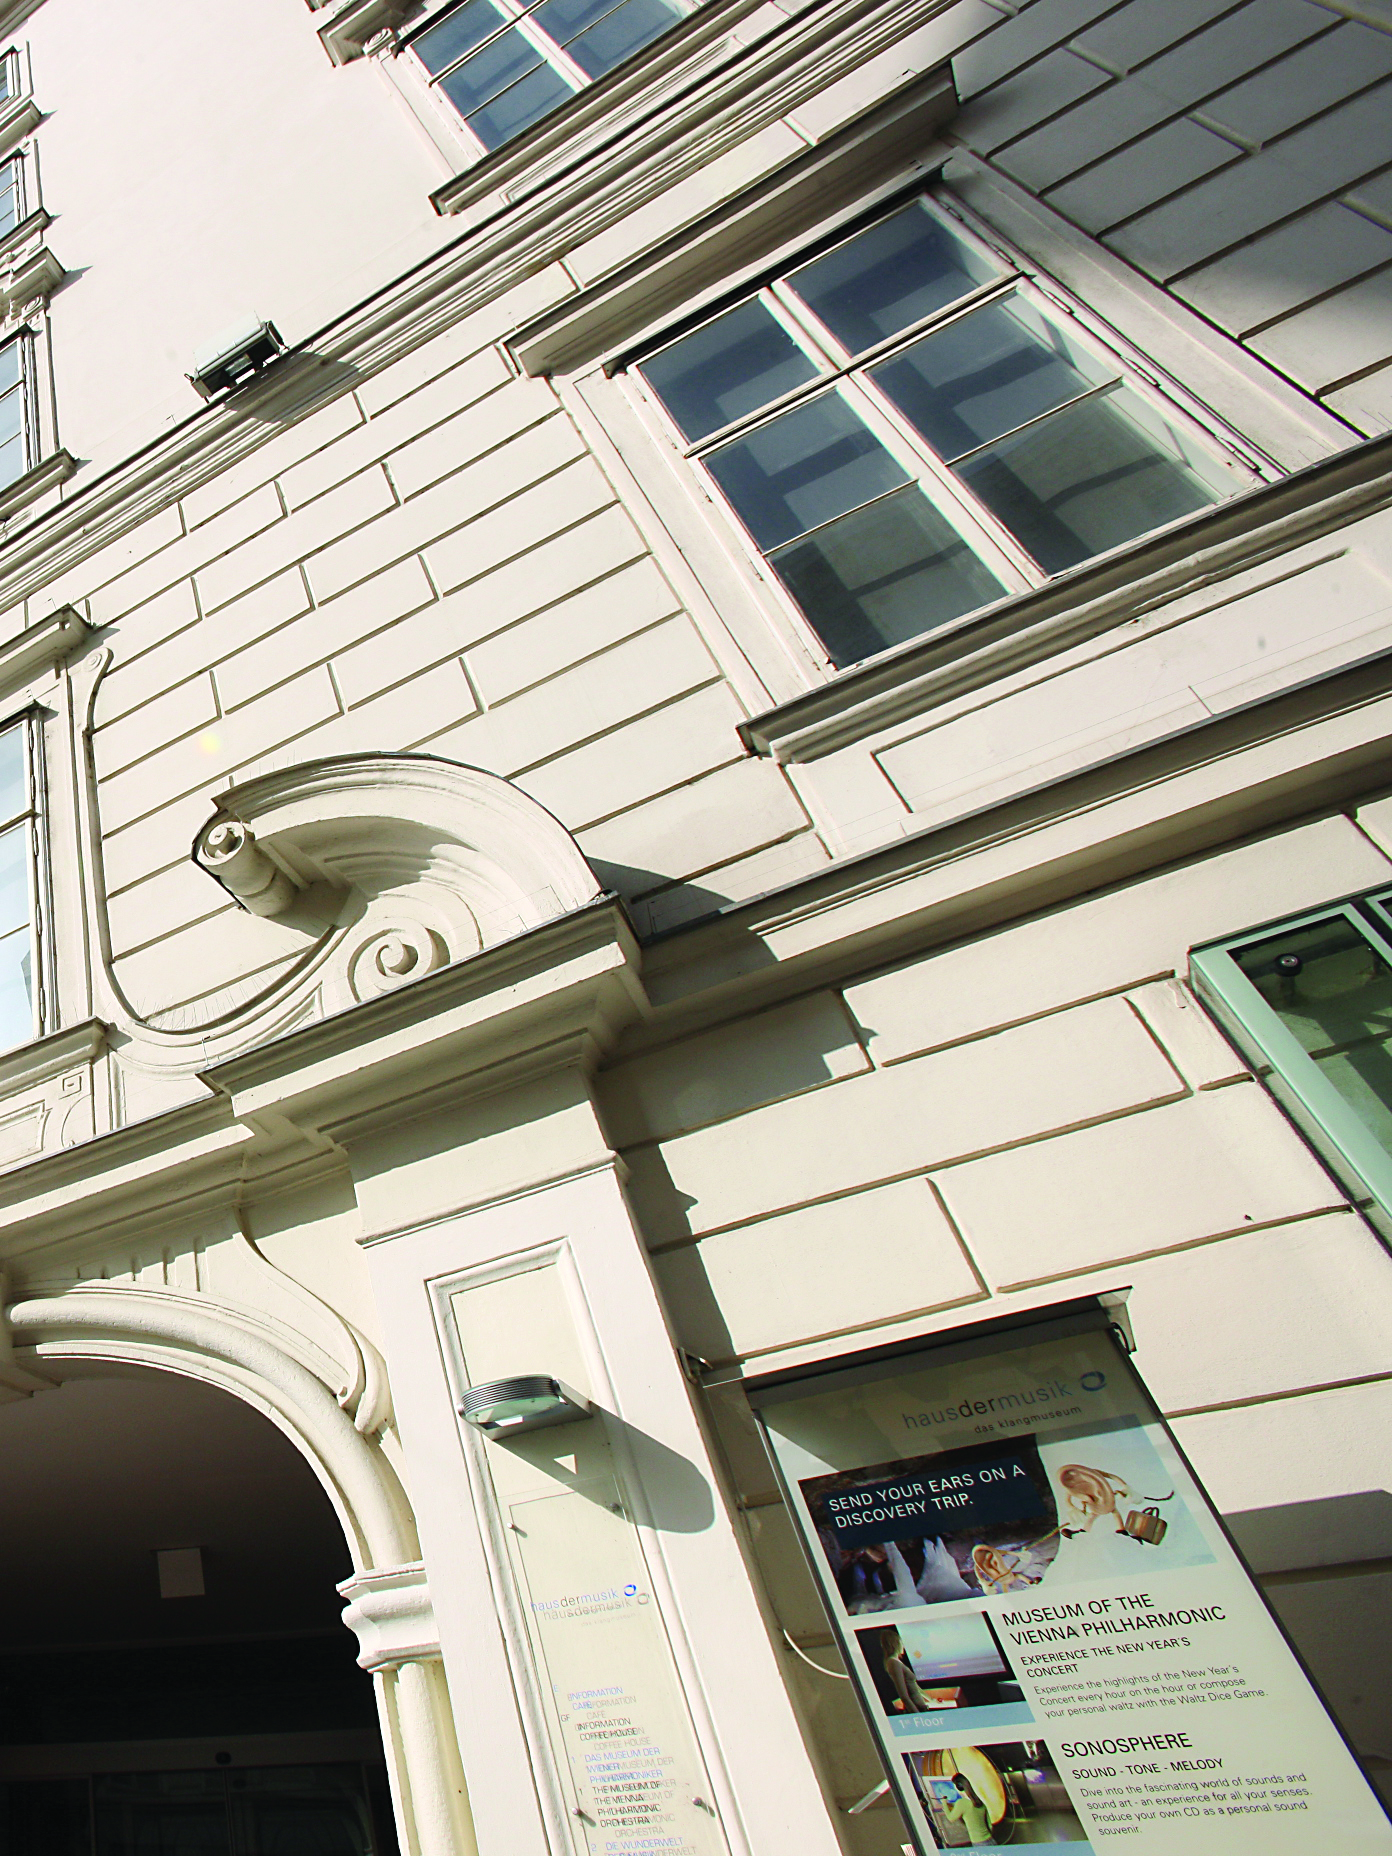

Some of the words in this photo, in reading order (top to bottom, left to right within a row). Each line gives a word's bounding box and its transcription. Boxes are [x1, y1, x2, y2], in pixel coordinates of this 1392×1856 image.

[901, 1380, 1073, 1429] hausdermusik
[974, 1422, 995, 1434] das
[998, 1404, 1082, 1429] klangmuseum
[829, 1492, 873, 1511] SEND
[877, 1482, 925, 1503] YOUR
[929, 1473, 974, 1492] EARS
[979, 1467, 1007, 1484] ON
[1013, 1464, 1026, 1477] A
[835, 1502, 926, 1528] DISCOVERY
[931, 1492, 974, 1511] TRIP.
[1002, 1603, 1085, 1626] MUSEUM
[1087, 1598, 1112, 1614] OF
[1114, 1593, 1155, 1611] THE
[1010, 1625, 1080, 1646] VIENNA
[1082, 1605, 1227, 1637] PHILHARMONIC
[1020, 1648, 1090, 1666] EXPERIENCE
[1091, 1646, 1114, 1658] THE
[1115, 1641, 1145, 1654] NEW
[1026, 1663, 1079, 1678] CONCERT
[1033, 1680, 1085, 1696] Experience
[1086, 1679, 1102, 1690] the
[1103, 1673, 1150, 1690] highlights
[1151, 1672, 1163, 1684] of
[1163, 1670, 1181, 1681] the
[1182, 1667, 1206, 1679] New
[1039, 1694, 1076, 1707] Concert
[1077, 1692, 1103, 1705] every
[1104, 1688, 1127, 1700] hour
[1128, 1688, 1142, 1697] on
[1143, 1685, 1160, 1696] the
[1161, 1682, 1185, 1693] hour
[1186, 1683, 1198, 1691] or
[1199, 1677, 1247, 1692] compose
[1045, 1708, 1065, 1720] your
[1067, 1703, 1108, 1717] personal
[1108, 1700, 1135, 1711] waltz
[1136, 1697, 1159, 1709] with
[1159, 1695, 1177, 1706] the
[1178, 1692, 1207, 1705] Waltz
[1208, 1690, 1232, 1702] Dice
[1233, 1687, 1269, 1699] Game.
[913, 1716, 944, 1728] Floor
[585, 1753, 602, 1762] DAS
[603, 1749, 641, 1760] MUSEUM
[642, 1746, 660, 1756] DER
[1061, 1732, 1193, 1758] SONOSPHERE
[1071, 1766, 1117, 1780] SOUND
[1125, 1762, 1162, 1776] TONE
[1170, 1757, 1225, 1772] MELODY
[1080, 1786, 1103, 1798] Dive
[1104, 1785, 1124, 1796] into
[1125, 1783, 1143, 1794] the
[1143, 1780, 1200, 1794] fascinating
[1200, 1777, 1231, 1789] world
[1231, 1776, 1243, 1787] of
[1245, 1774, 1284, 1786] sounds
[1285, 1772, 1308, 1783] and
[1086, 1799, 1116, 1811] sound
[1118, 1798, 1133, 1808] art
[1141, 1798, 1154, 1806] an
[1155, 1793, 1211, 1807] experience
[1211, 1791, 1228, 1802] for
[1230, 1789, 1243, 1800] all
[1244, 1789, 1268, 1801] your
[1270, 1786, 1313, 1798] senses.
[1092, 1811, 1133, 1824] Produce
[1134, 1810, 1157, 1822] your
[1159, 1809, 1183, 1818] own
[1183, 1806, 1200, 1817] CD
[1202, 1807, 1216, 1816] as
[1218, 1806, 1225, 1815] a
[1226, 1802, 1273, 1816] personal
[1274, 1800, 1308, 1812] sound
[606, 1841, 619, 1850] DIE
[621, 1837, 683, 1850] WUNDERWELT
[1098, 1825, 1143, 1836] souvenir.
